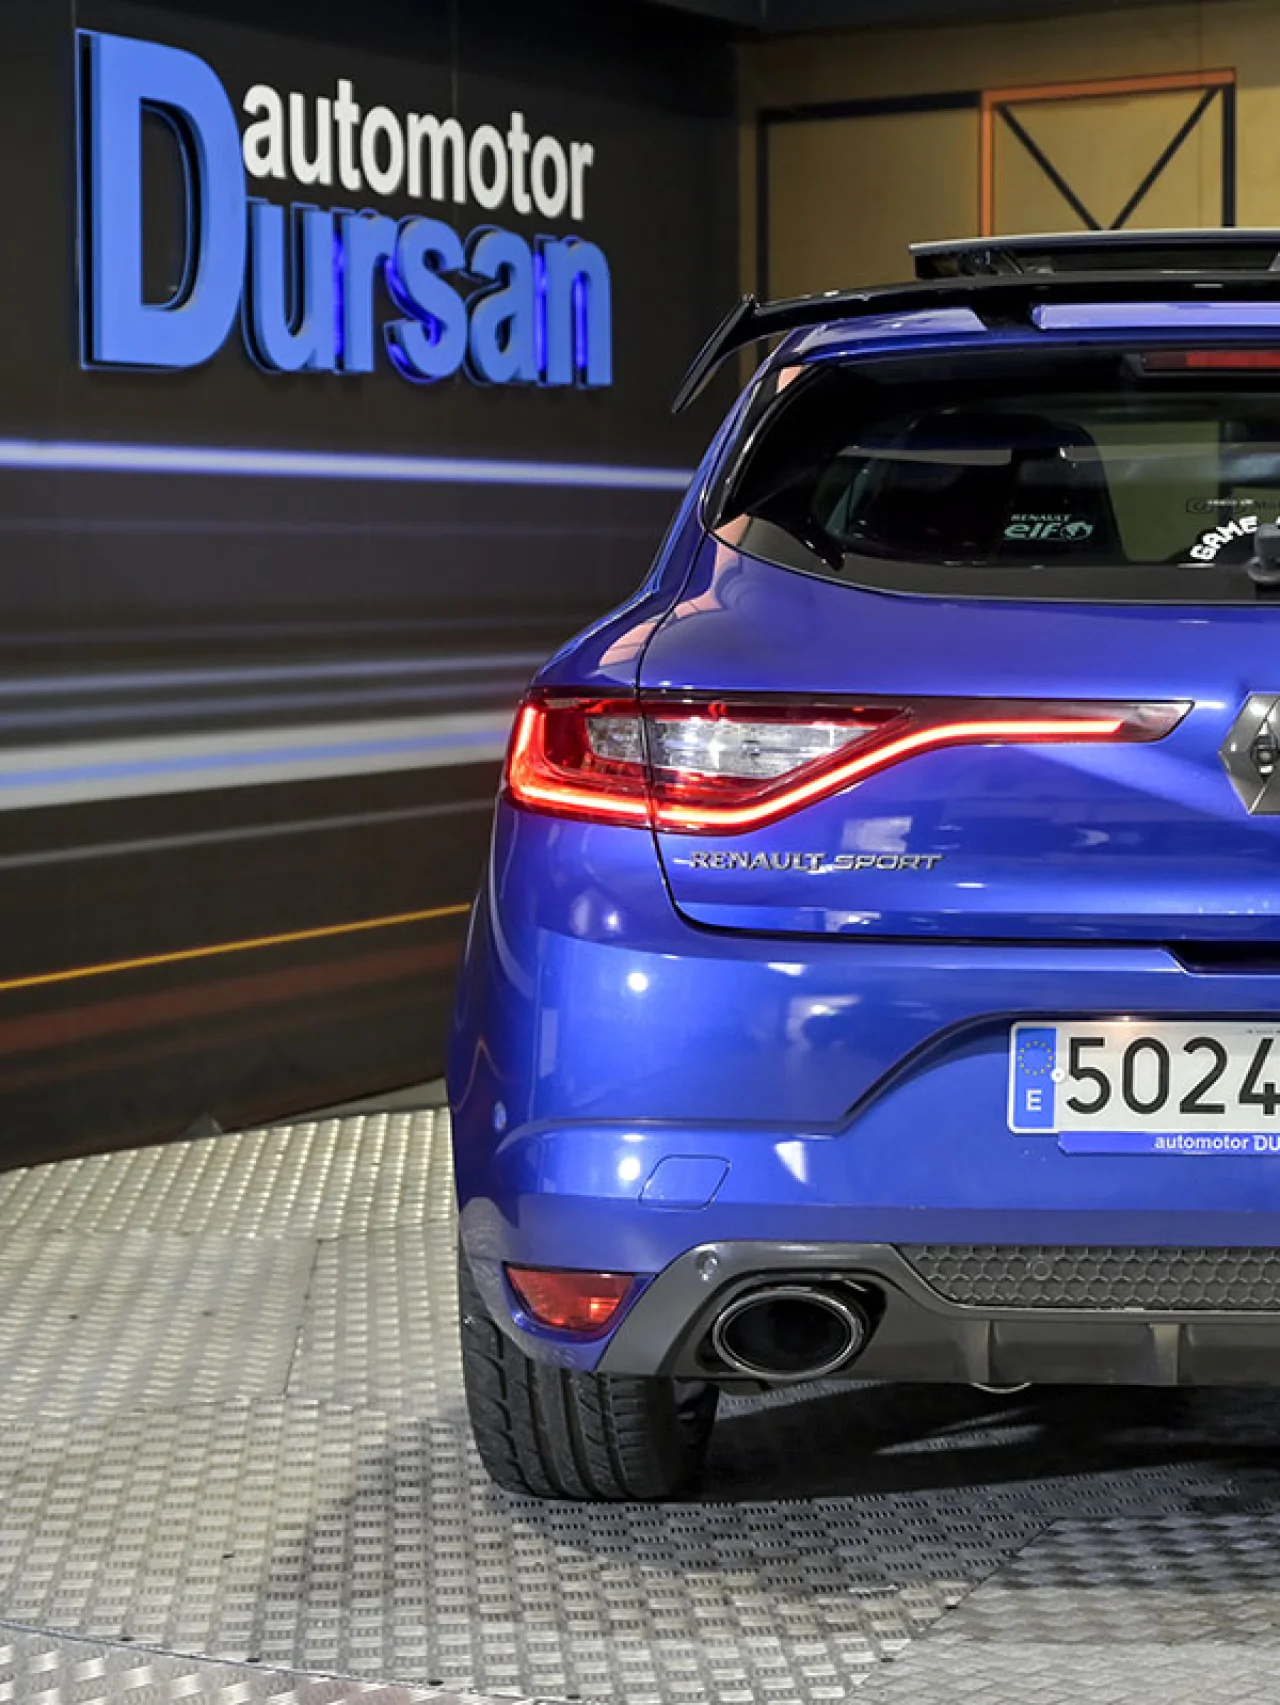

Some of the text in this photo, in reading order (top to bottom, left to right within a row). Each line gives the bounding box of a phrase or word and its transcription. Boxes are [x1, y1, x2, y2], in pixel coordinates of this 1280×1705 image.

[243, 78, 594, 221] automotor
[75, 27, 613, 388] Dursan
[1189, 515, 1258, 560] GAME
[688, 851, 942, 871] RENAULT SPORT
[1026, 1090, 1042, 1112] E
[1155, 1134, 1250, 1150] automotor
